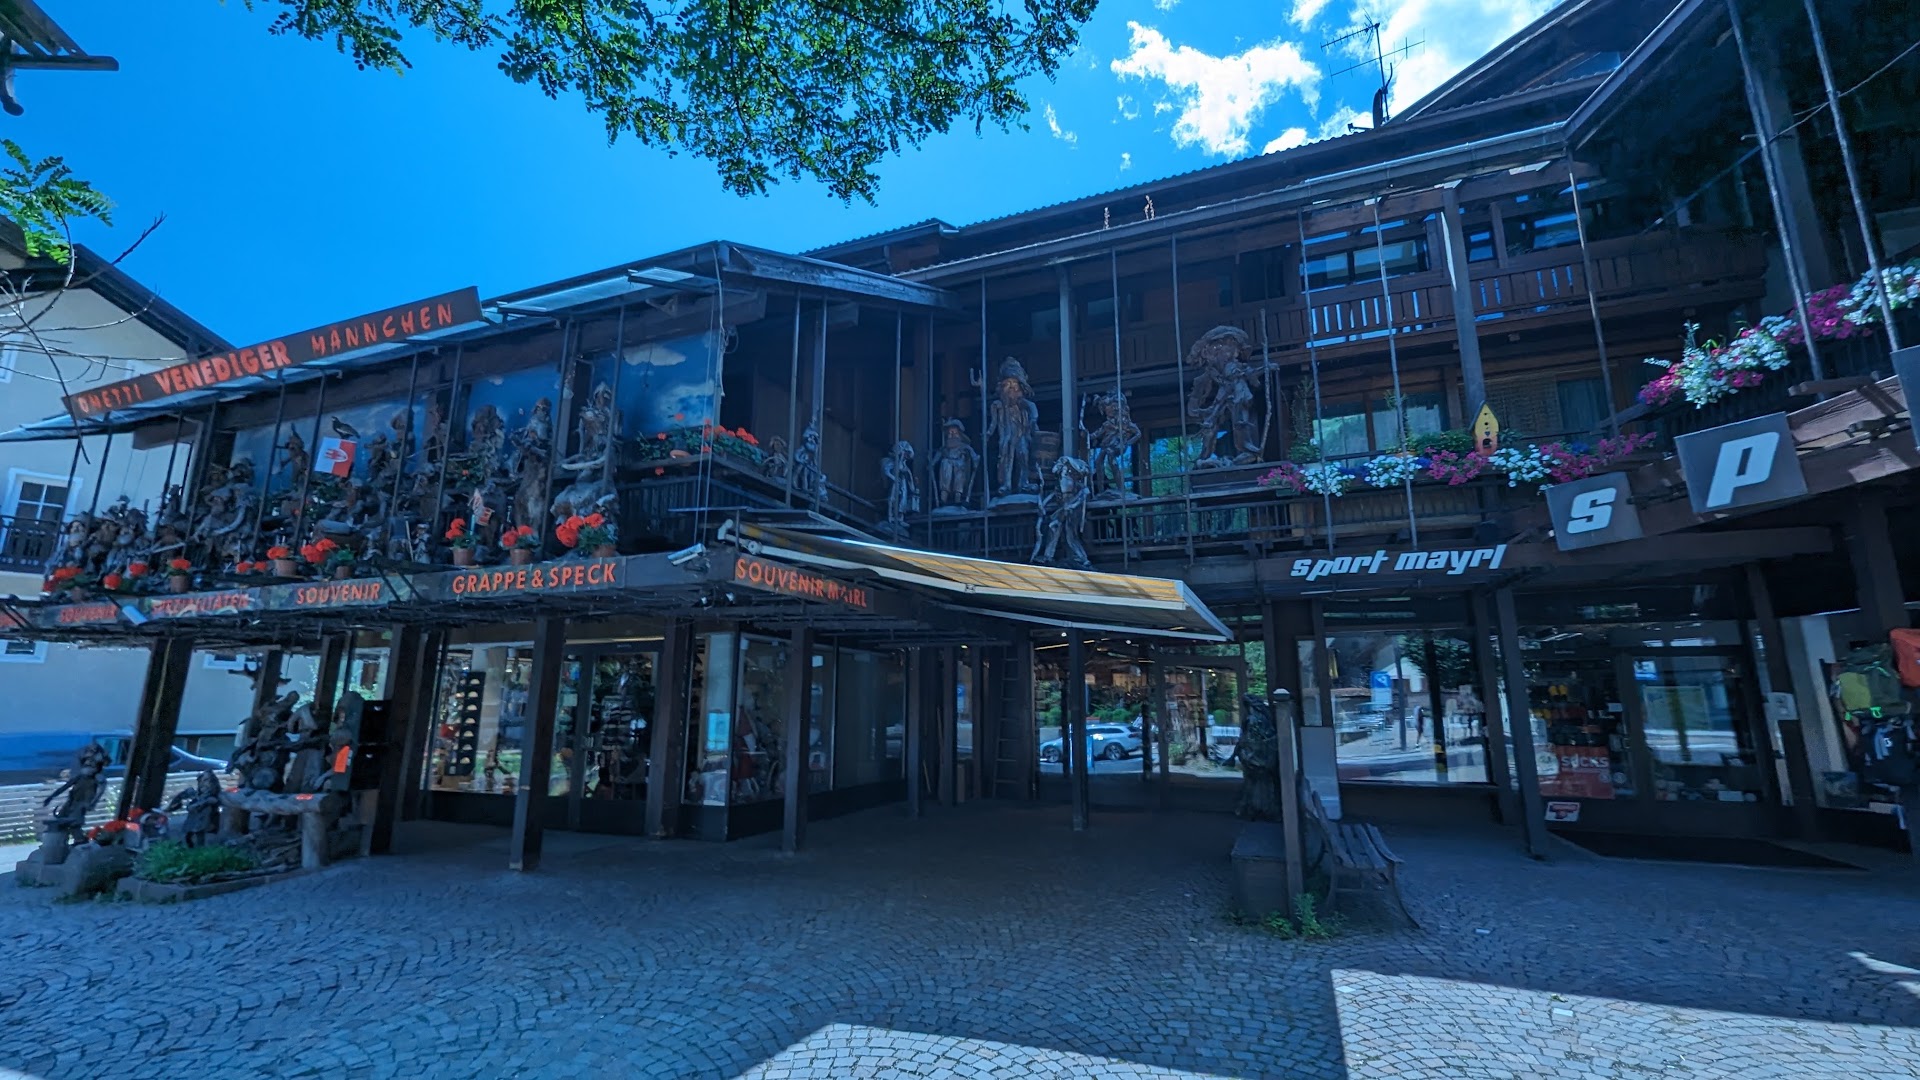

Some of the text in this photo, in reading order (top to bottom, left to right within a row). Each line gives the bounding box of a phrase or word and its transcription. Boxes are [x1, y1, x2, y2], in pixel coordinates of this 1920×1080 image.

[154, 341, 292, 394] VENEDIGER
[311, 302, 453, 357] MÄNNCHEN
[452, 562, 617, 594] GRAPPE & SPECK
[736, 558, 824, 597] SOUVENIR
[1291, 544, 1508, 582] sport mayrl
[296, 582, 381, 605] SOUVENIR
